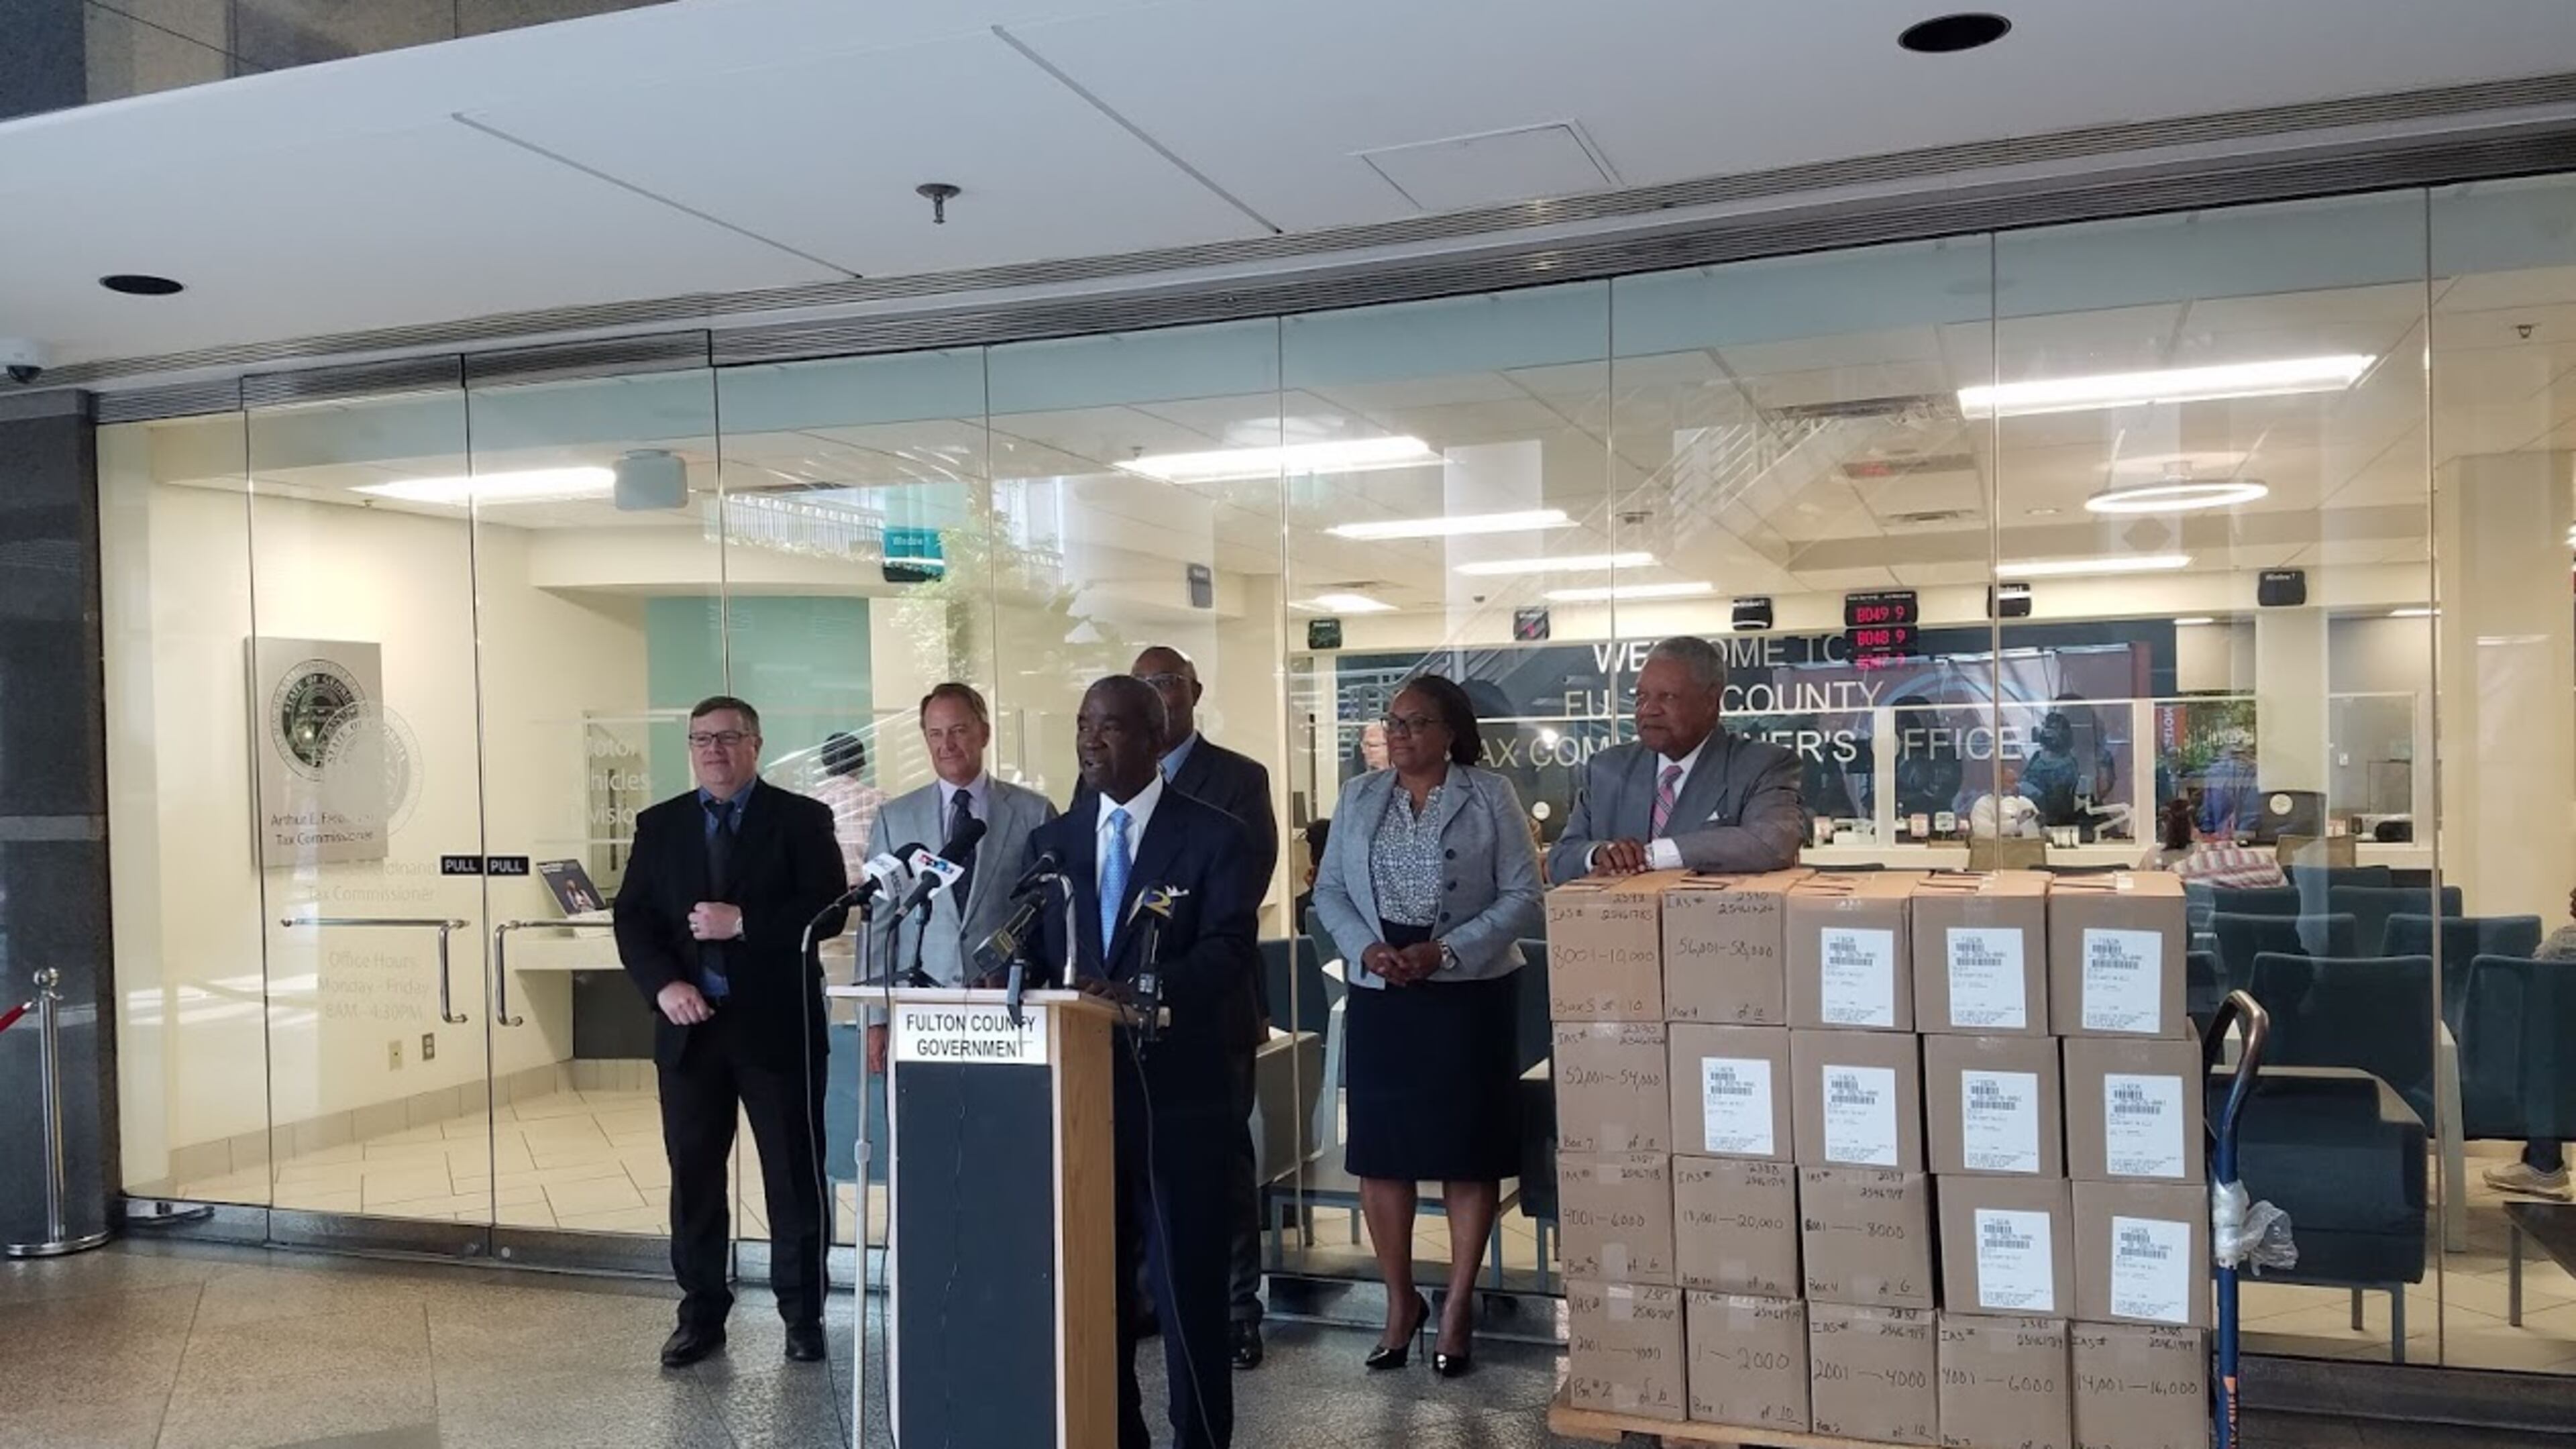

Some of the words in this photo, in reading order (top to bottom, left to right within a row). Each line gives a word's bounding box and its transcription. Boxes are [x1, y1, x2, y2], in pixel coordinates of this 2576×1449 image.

[1895, 605, 1905, 621] 9
[1896, 629, 1905, 644] 9
[1719, 680, 1884, 712] COUNTY
[1474, 738, 1519, 767] AX
[276, 834, 294, 846] Tax
[444, 859, 477, 872] PULL
[490, 859, 523, 872] PULL
[306, 885, 329, 902] Tax
[333, 885, 435, 902] Commissioner
[328, 950, 370, 969] Office
[317, 976, 374, 996] Monday
[906, 1014, 966, 1032] FULTON
[971, 1014, 1036, 1033] COUNY
